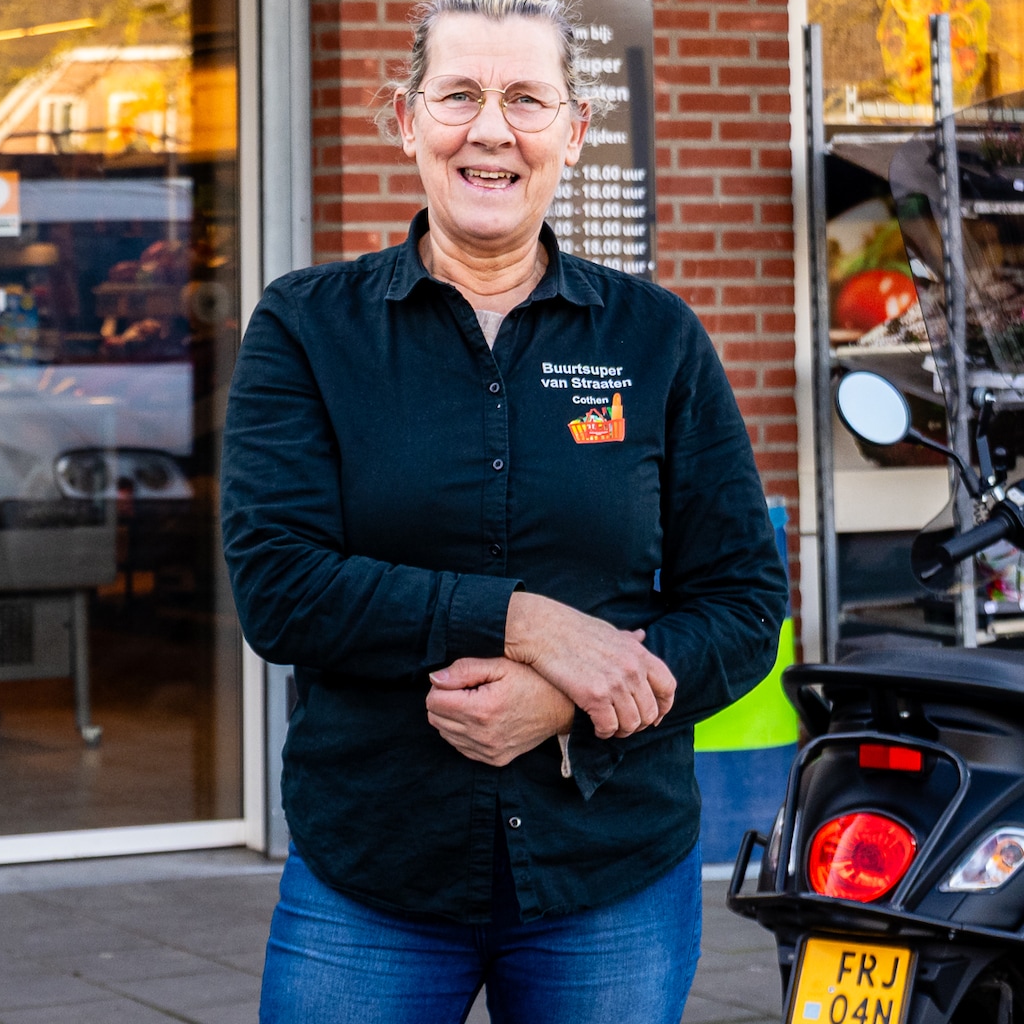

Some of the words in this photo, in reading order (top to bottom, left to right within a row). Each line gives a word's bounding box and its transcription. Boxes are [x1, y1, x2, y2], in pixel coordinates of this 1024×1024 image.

[582, 164, 622, 181] 18.00
[622, 168, 645, 182] uur
[582, 183, 622, 199] 18.00
[622, 186, 645, 200] uur
[582, 201, 622, 218] 18.00
[622, 205, 646, 218] uur
[582, 220, 622, 237] 18.00
[622, 223, 646, 237] uur
[582, 238, 622, 255] 18.00
[622, 242, 646, 255] uur
[623, 260, 646, 274] uur
[541, 362, 624, 378] Buurtsuper
[541, 378, 568, 389] van
[571, 377, 633, 390] Straaten
[572, 395, 609, 405] Cothen
[837, 951, 900, 989] FRJ
